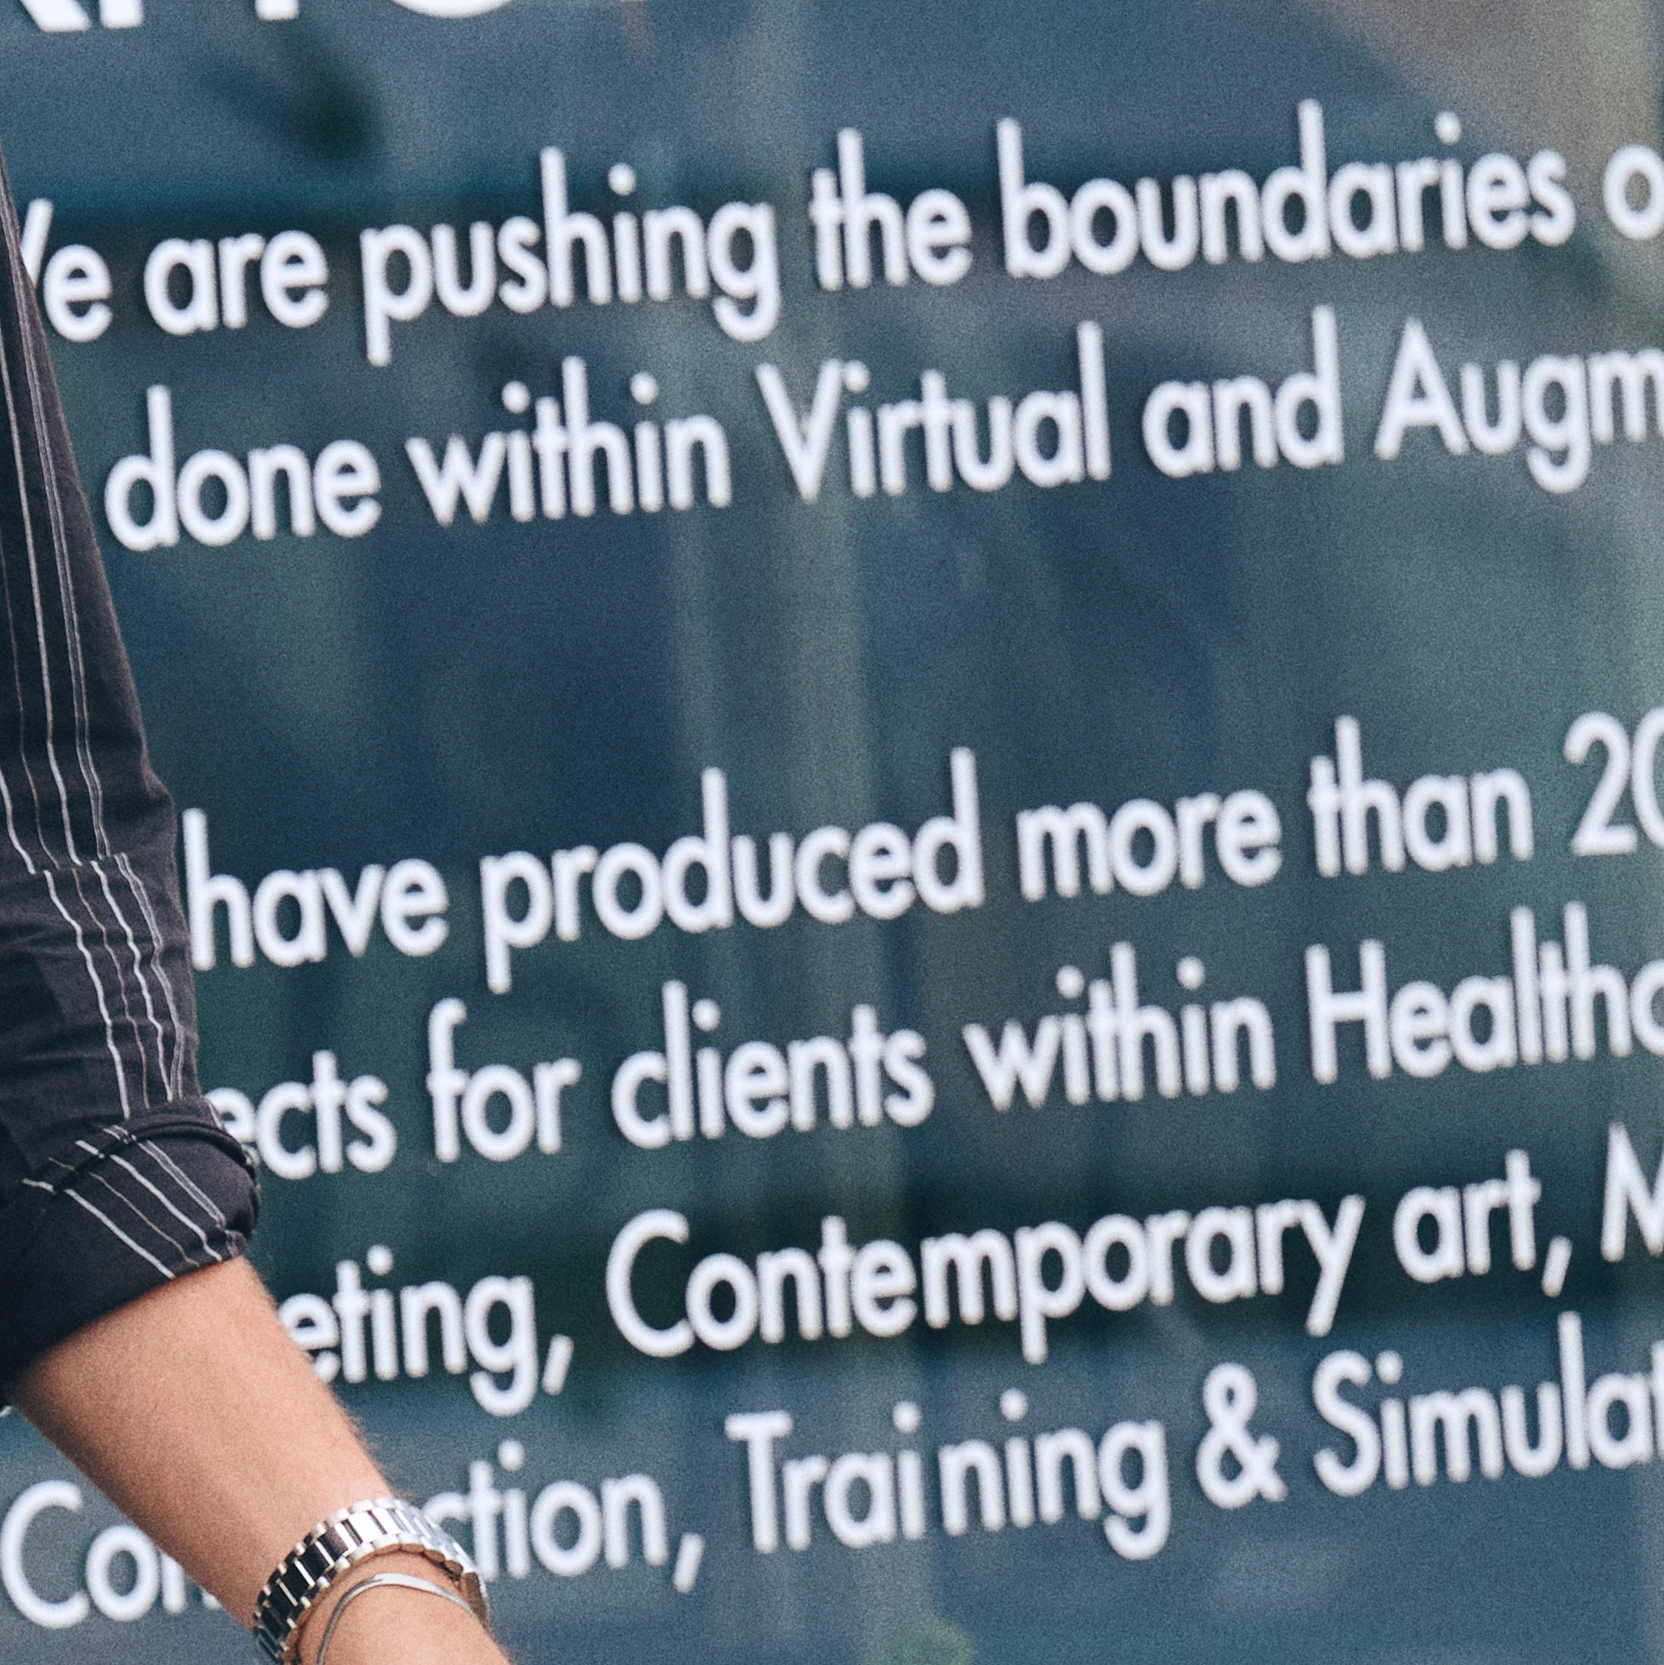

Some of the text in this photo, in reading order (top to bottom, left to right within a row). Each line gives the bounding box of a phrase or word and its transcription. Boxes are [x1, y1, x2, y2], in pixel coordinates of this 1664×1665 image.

[143, 230, 329, 336] are
[360, 145, 783, 367] pushing
[808, 127, 972, 291] the
[996, 99, 1578, 280] boundaries
[104, 384, 381, 552] done
[405, 355, 732, 524] within
[753, 321, 1111, 503] Virtual
[1143, 304, 1345, 477] and
[182, 808, 449, 971] have
[480, 747, 985, 992] produced
[1016, 789, 1282, 901] more
[1307, 716, 1535, 877] than
[426, 997, 581, 1163] for
[611, 980, 935, 1149] clients
[963, 941, 1276, 1109] within
[605, 1195, 1372, 1373] Contemporary
[1393, 1149, 1572, 1295] art,
[725, 1389, 1171, 1560] Training
[1196, 1362, 1285, 1509] &
